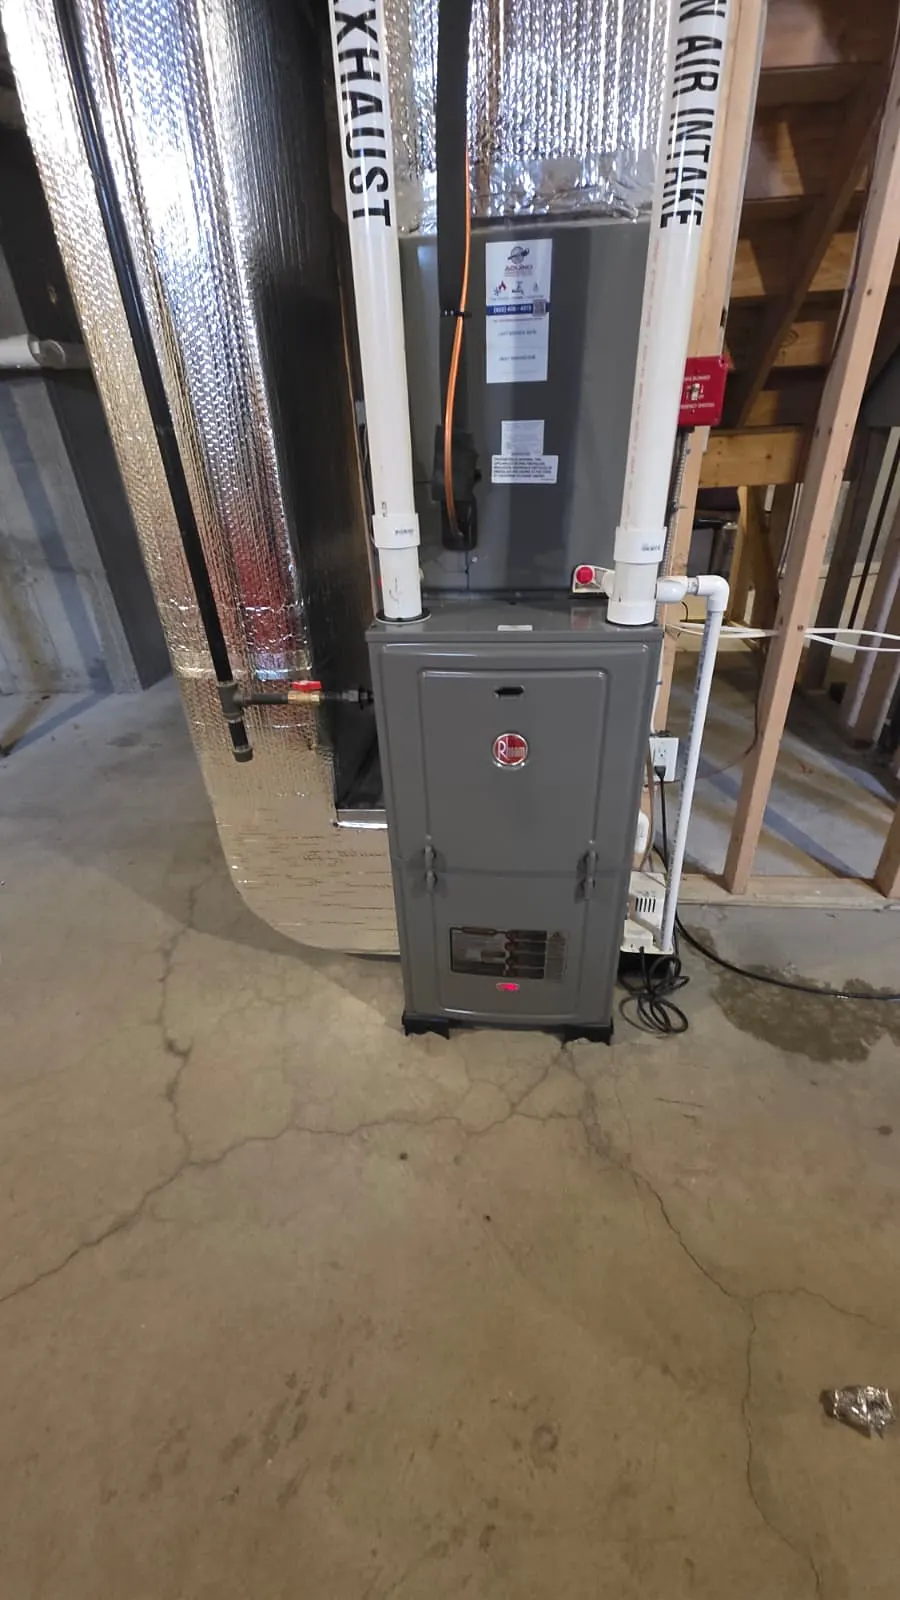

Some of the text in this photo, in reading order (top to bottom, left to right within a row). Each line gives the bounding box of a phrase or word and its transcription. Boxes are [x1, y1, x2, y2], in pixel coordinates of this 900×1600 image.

[334, 0, 391, 227] XHAUST
[673, 36, 723, 98] AIR
[660, 108, 714, 228] INTAKE
